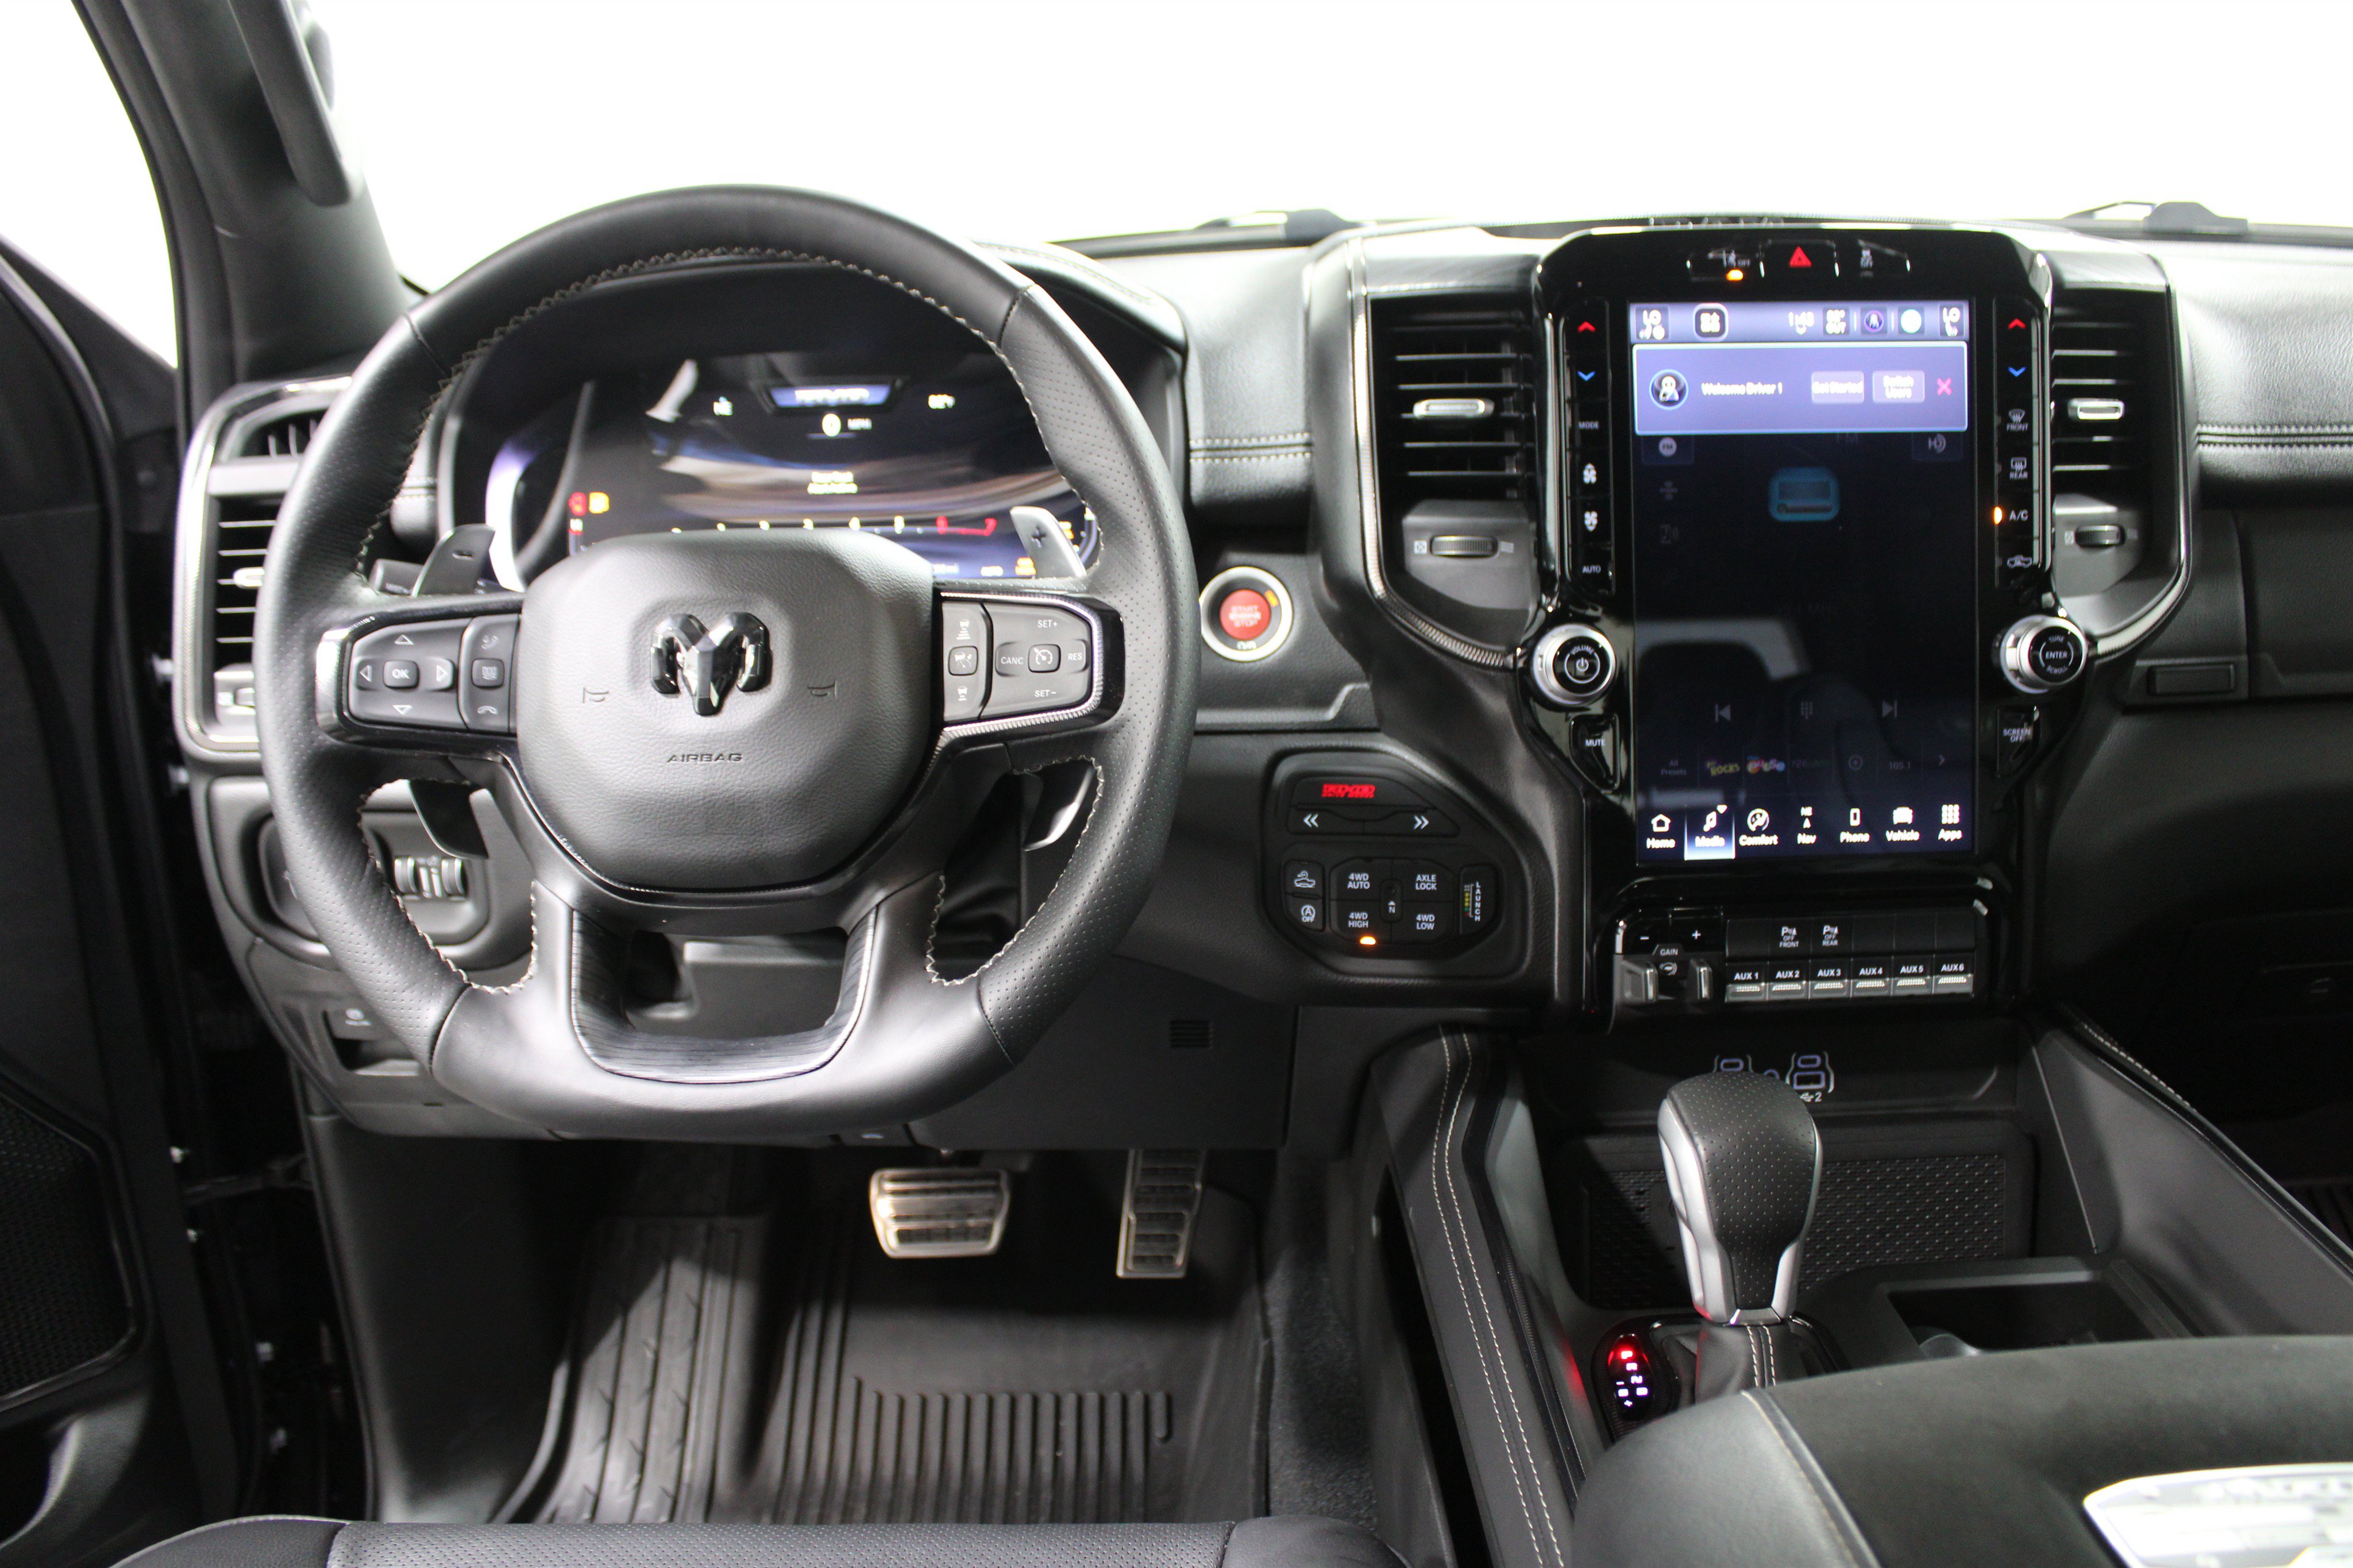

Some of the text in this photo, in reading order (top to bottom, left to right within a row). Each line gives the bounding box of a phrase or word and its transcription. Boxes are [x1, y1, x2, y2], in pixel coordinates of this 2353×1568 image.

[1579, 421, 1599, 429] MODE
[2007, 423, 2028, 431] FRONT
[2009, 509, 2028, 522] A/C
[1582, 565, 1601, 574] AUTO
[1570, 644, 1595, 655] VOLUME
[1068, 652, 1083, 661] RES
[2045, 651, 2068, 660] ENTER
[1001, 656, 1024, 665] CANC
[391, 668, 410, 679] OK
[2003, 728, 2031, 736] SCREEN
[1585, 739, 1606, 747] MUTE
[667, 753, 743, 763] AIRBAG
[1797, 833, 1817, 844] Nav
[1839, 831, 1870, 843] Phone
[1885, 829, 1920, 841] Vehicle
[1938, 828, 1962, 842] Apps
[1646, 837, 1676, 849] Home
[1695, 835, 1725, 847] Media
[1739, 834, 1779, 846] Comfort
[1348, 873, 1369, 882] 4WD
[1416, 874, 1437, 882] AXLE
[1347, 881, 1370, 890] AUTO
[1415, 882, 1437, 891] LOCK
[1388, 905, 1396, 914] N
[1348, 912, 1368, 920] 4WD
[1416, 914, 1435, 922] 4WD
[1348, 920, 1369, 929] HIGH
[1416, 922, 1435, 930] LOW
[1859, 967, 1883, 976] AUX 4
[1900, 965, 1924, 974] AUX 5
[1941, 963, 1965, 972] AUX 6
[1734, 973, 1752, 981] AUX
[1776, 970, 1800, 979] AUX 2
[1817, 968, 1841, 978] AUX 3
[1815, 1092, 1822, 1102] 2
